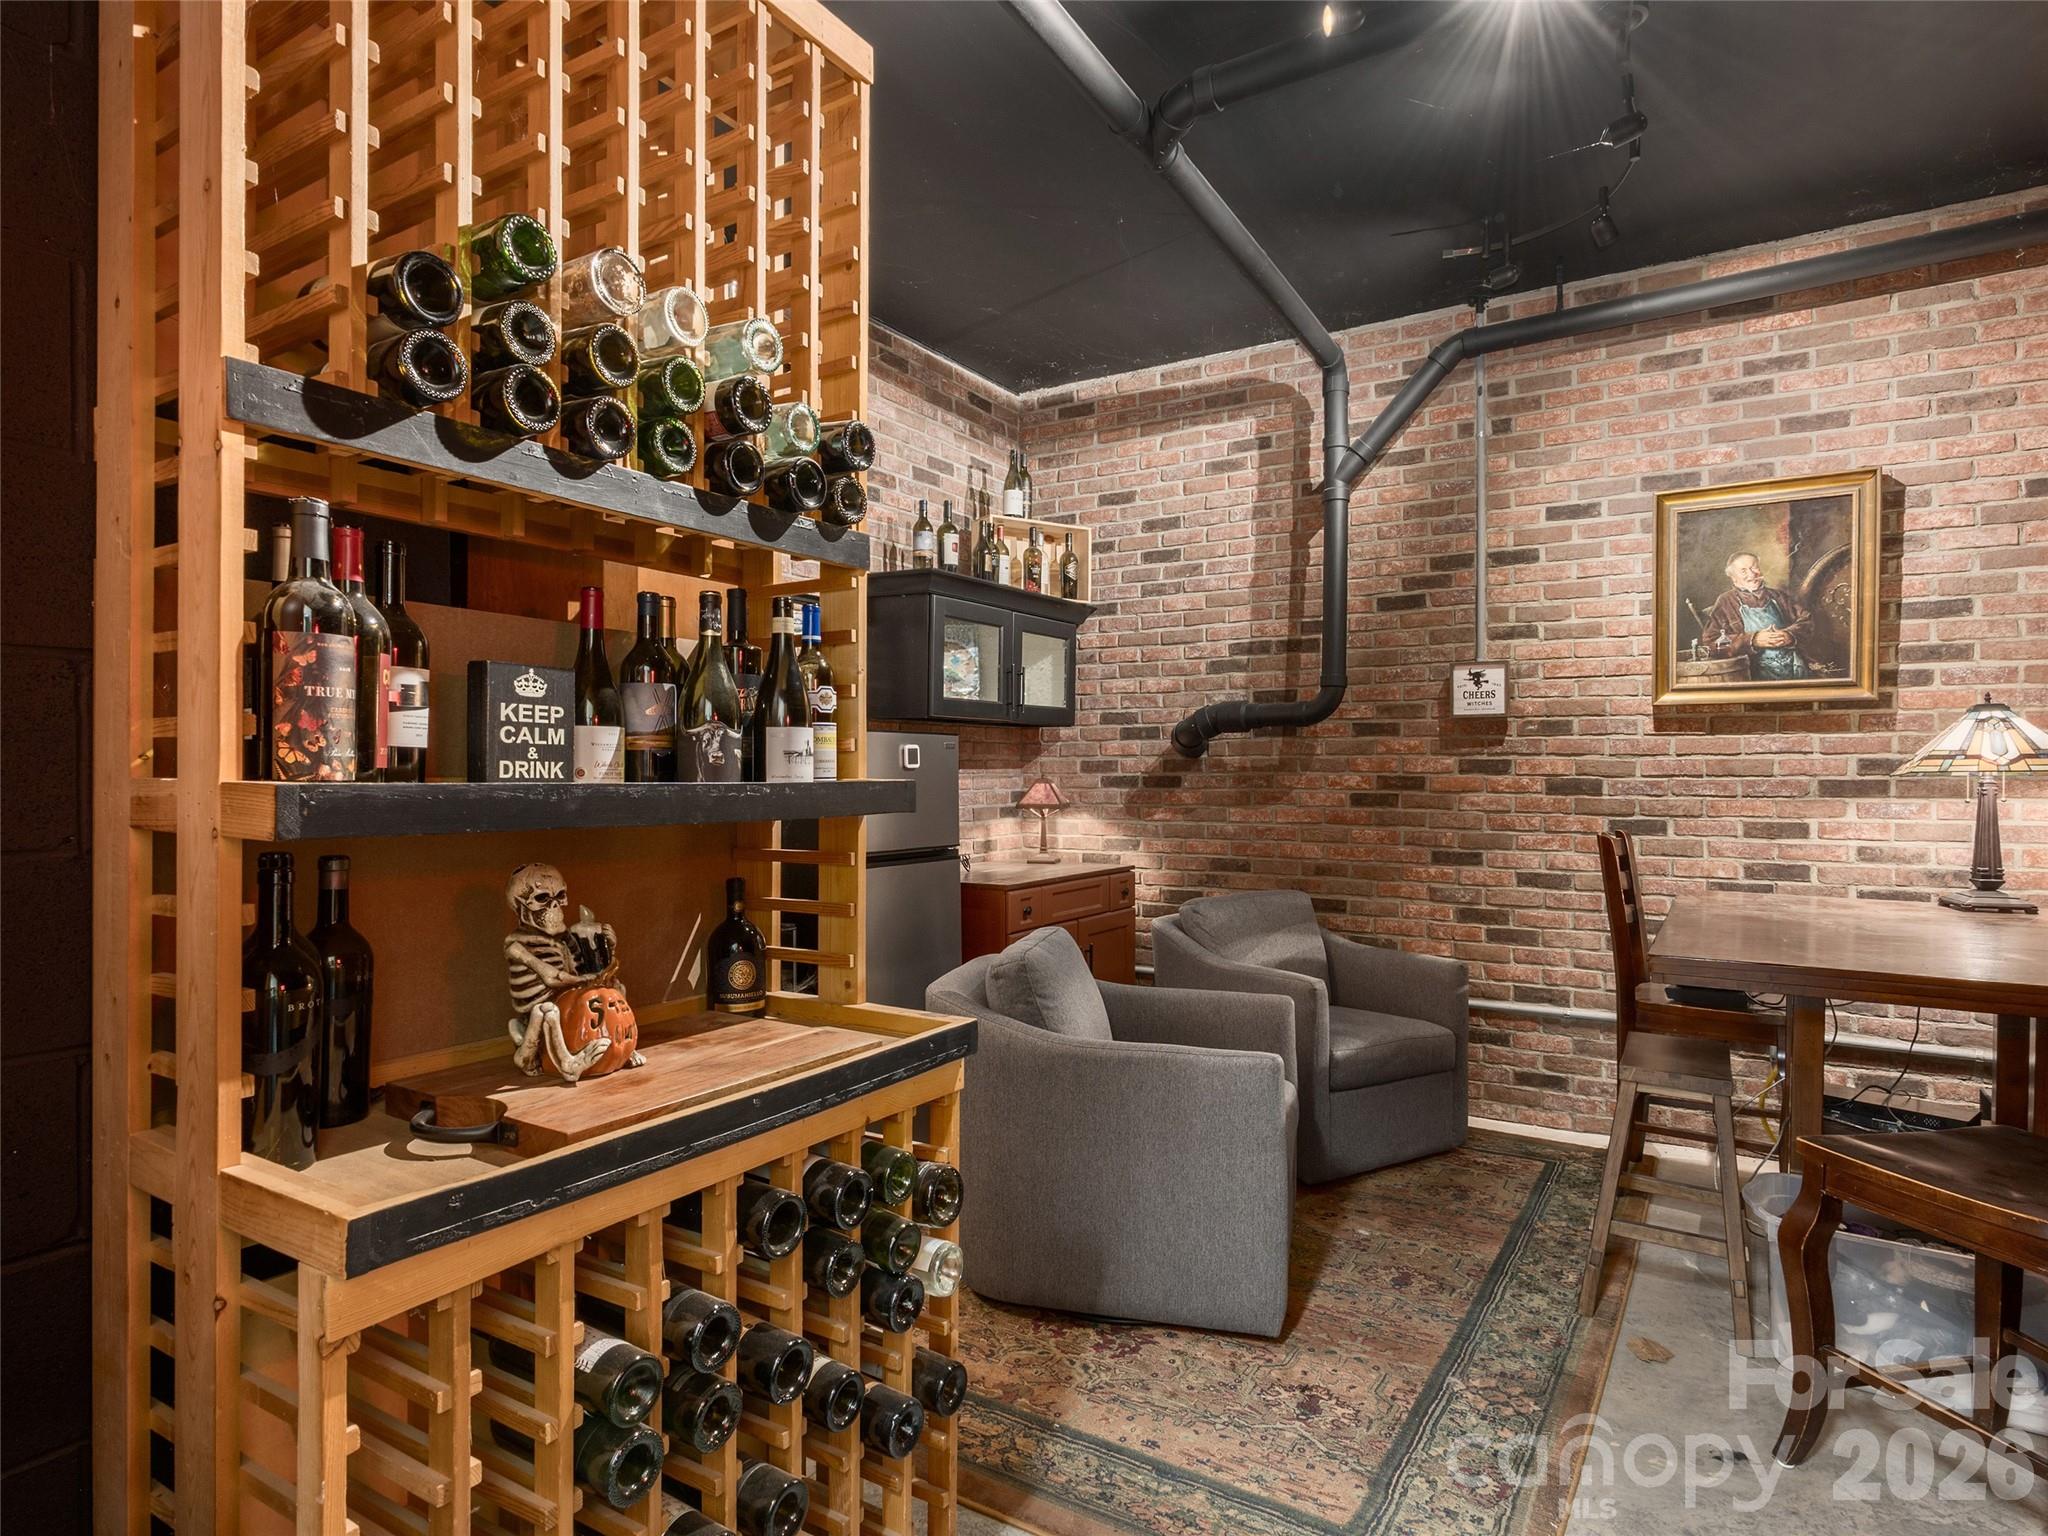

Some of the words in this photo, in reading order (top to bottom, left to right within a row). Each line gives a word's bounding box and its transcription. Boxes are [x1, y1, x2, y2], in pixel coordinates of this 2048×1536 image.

[303, 685, 343, 698] TRUE
[1462, 690, 1497, 700] CHEERS
[500, 702, 565, 724] KEEP
[499, 725, 565, 745] CALM
[527, 746, 539, 760] &
[498, 760, 565, 779] DRINK
